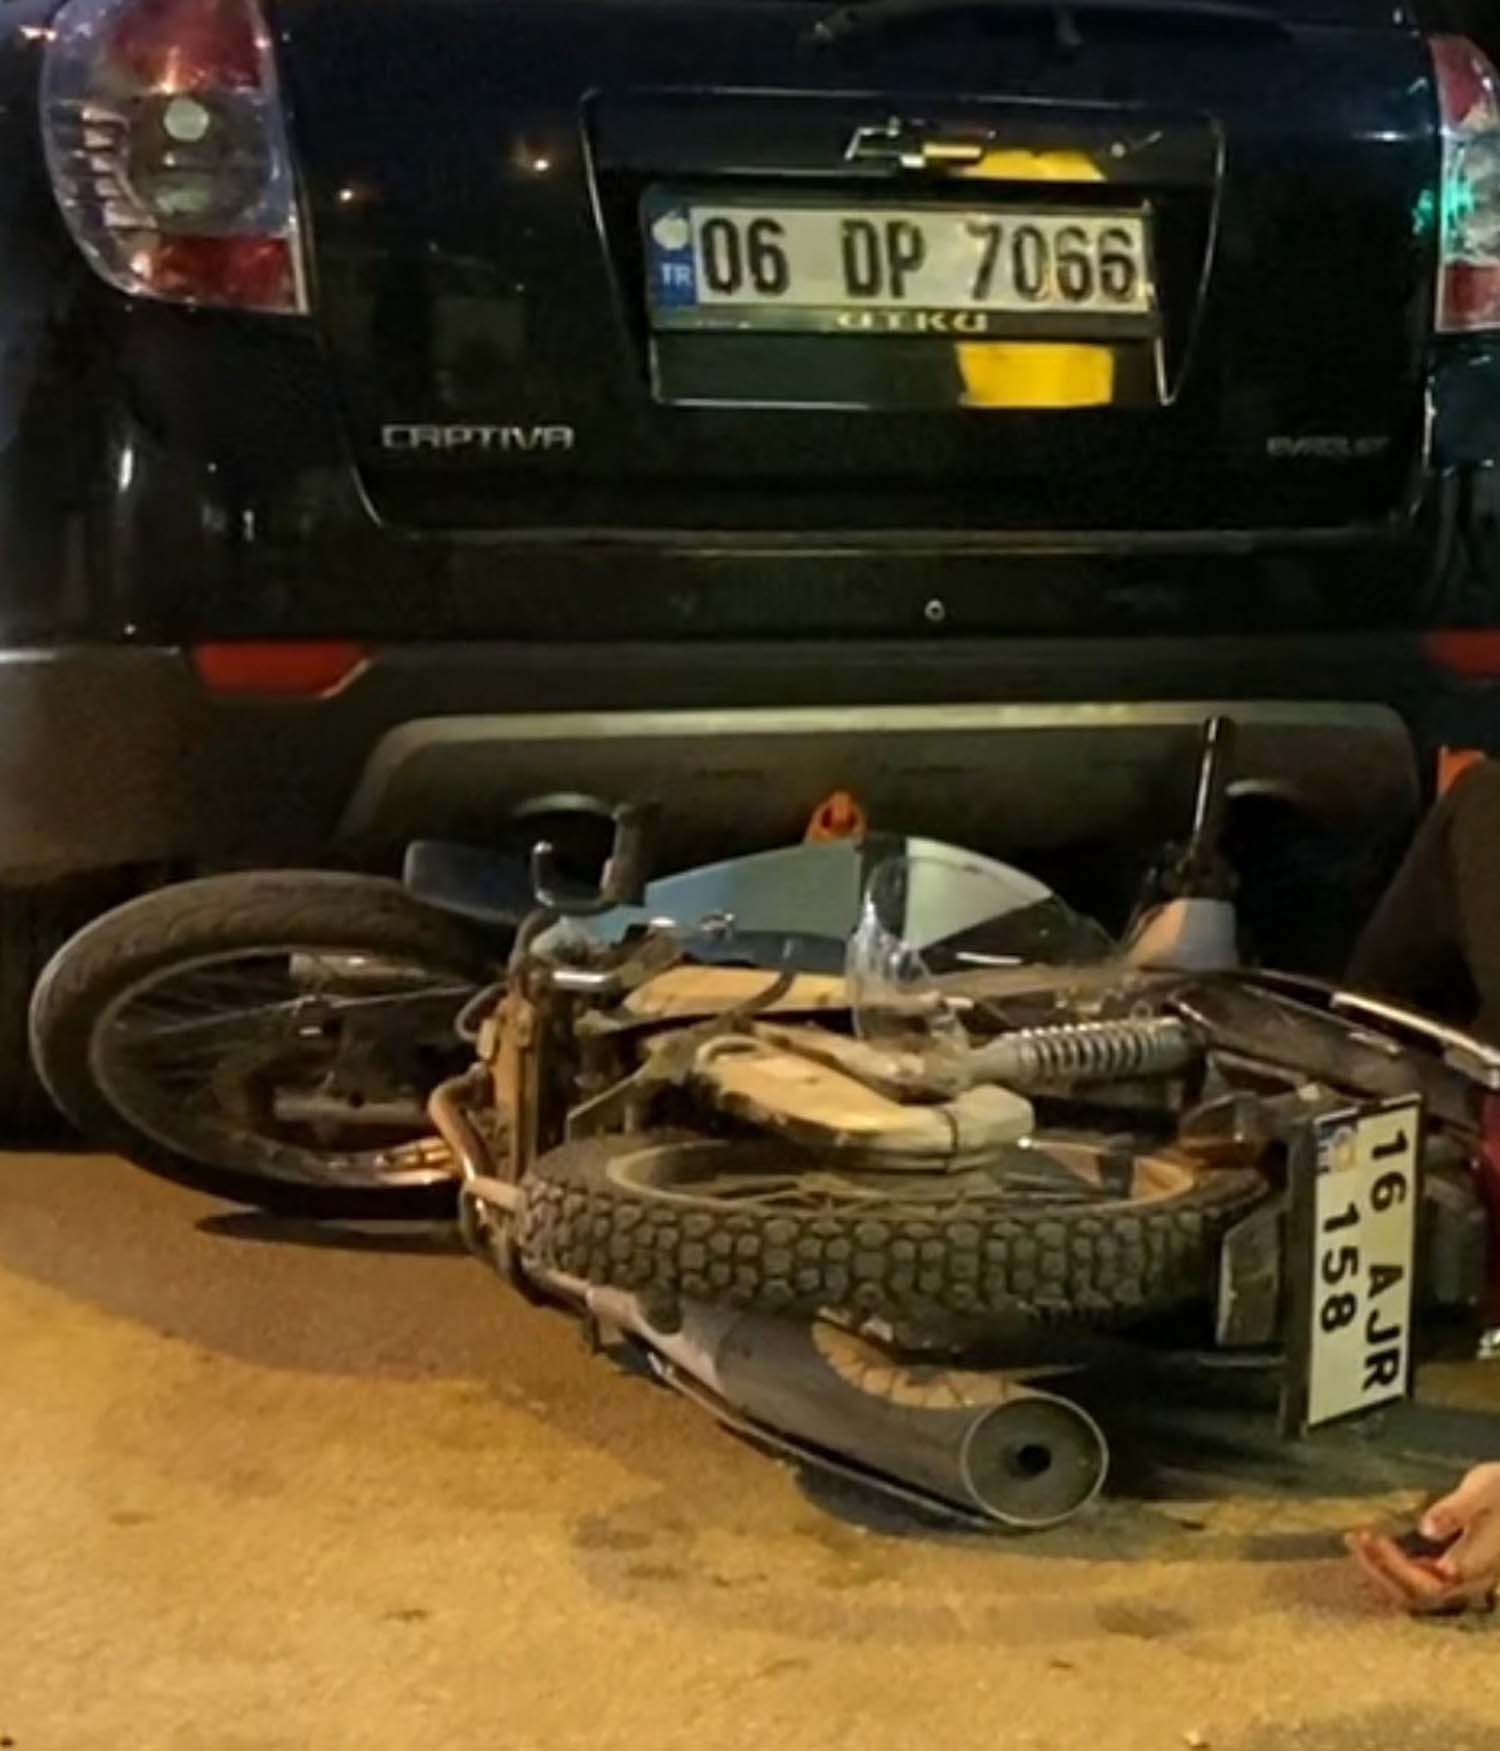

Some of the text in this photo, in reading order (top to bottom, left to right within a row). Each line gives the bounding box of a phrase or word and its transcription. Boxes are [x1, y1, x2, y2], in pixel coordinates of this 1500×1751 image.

[660, 262, 690, 286] TR
[701, 217, 1137, 303] 06 DP 7066
[381, 424, 575, 450] CAPTIVA
[1320, 1202, 1361, 1334] 158
[1362, 1129, 1408, 1392] 16 AJR
